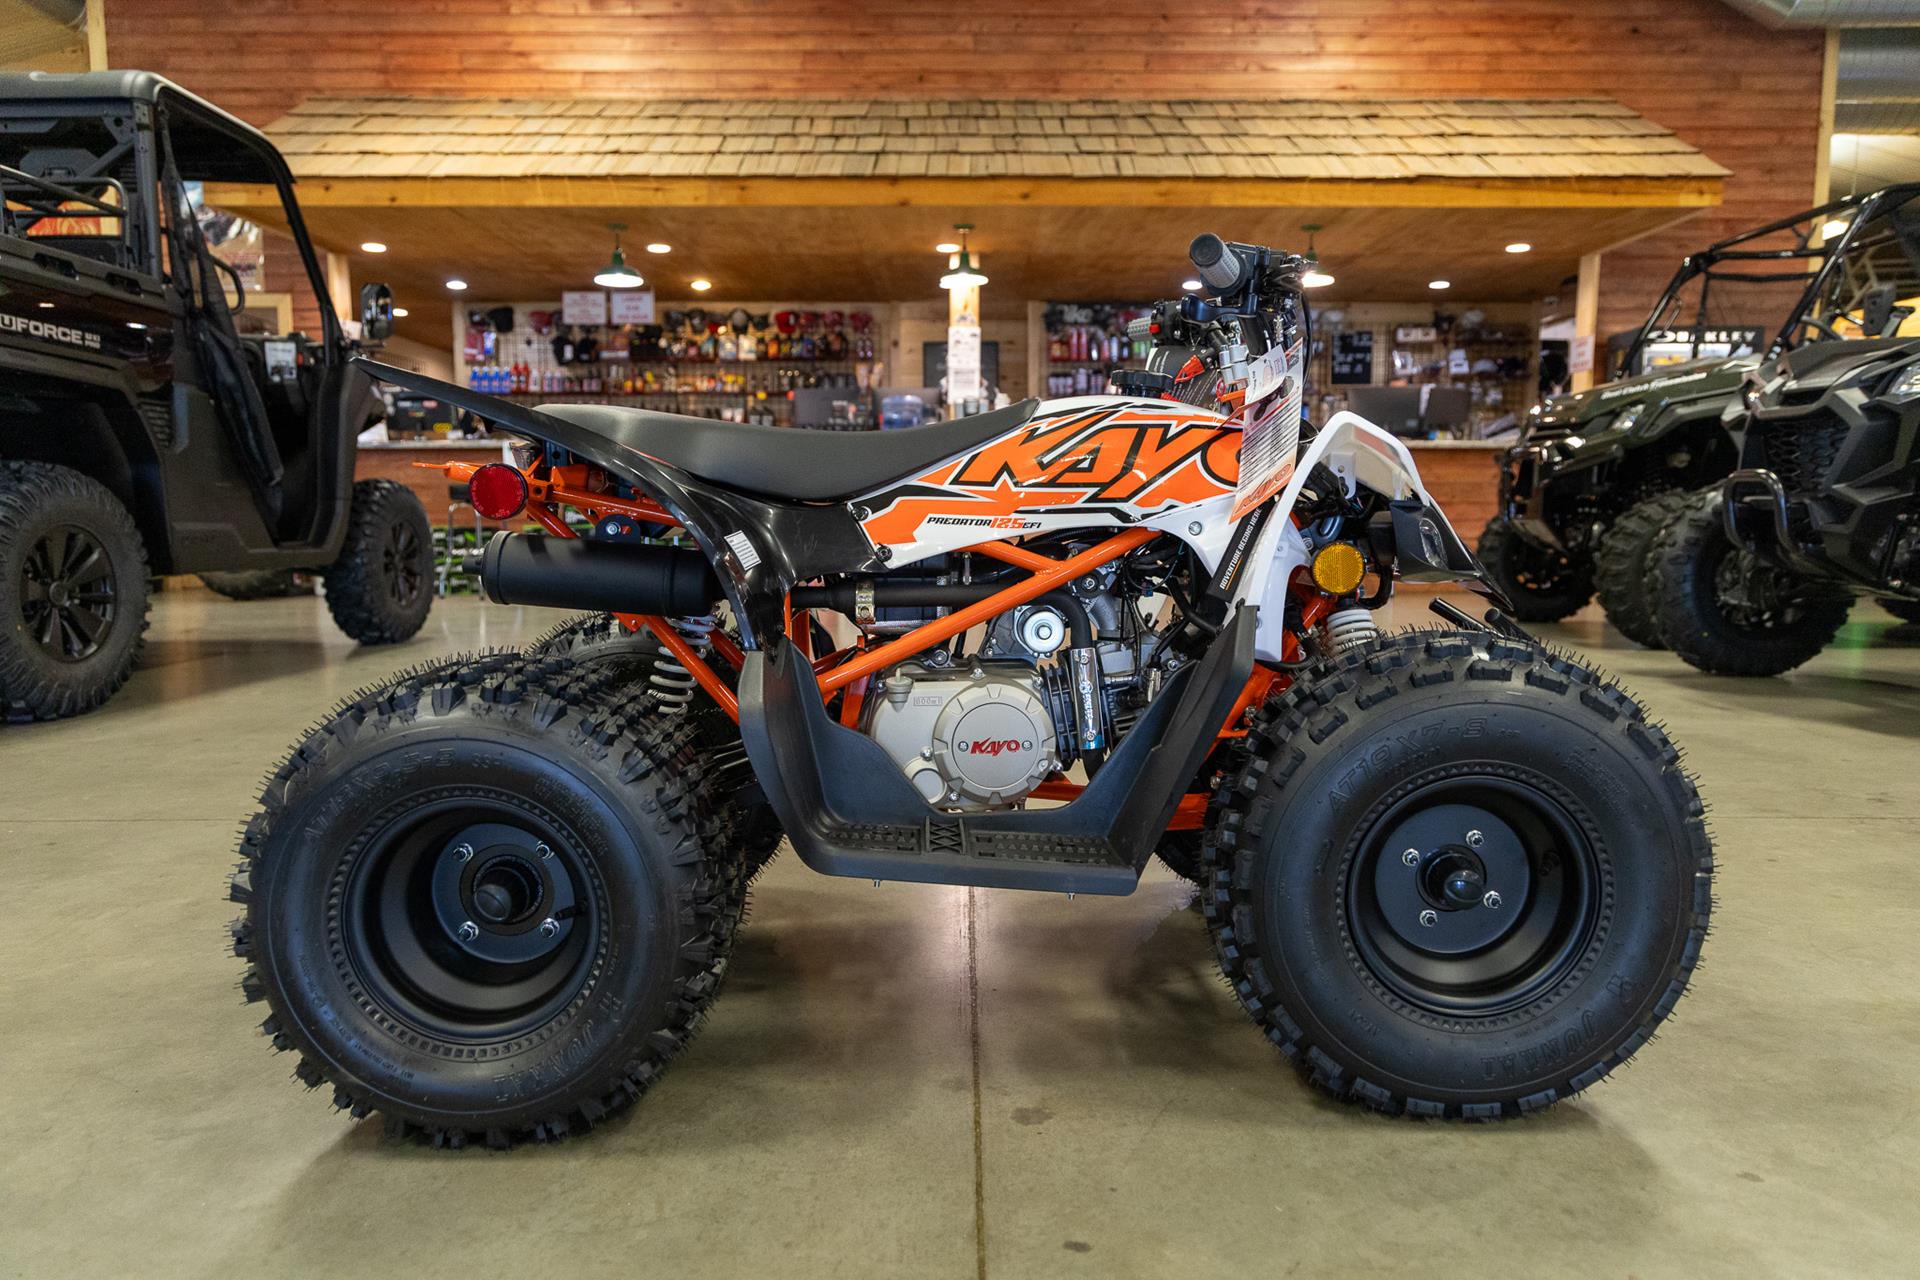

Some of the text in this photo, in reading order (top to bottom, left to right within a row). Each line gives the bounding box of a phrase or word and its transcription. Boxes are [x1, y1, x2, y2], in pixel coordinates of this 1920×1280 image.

[1219, 548, 1243, 590] ADVENTURE
[1237, 525, 1255, 552] BEGINS
[969, 736, 1021, 757] KAYO
